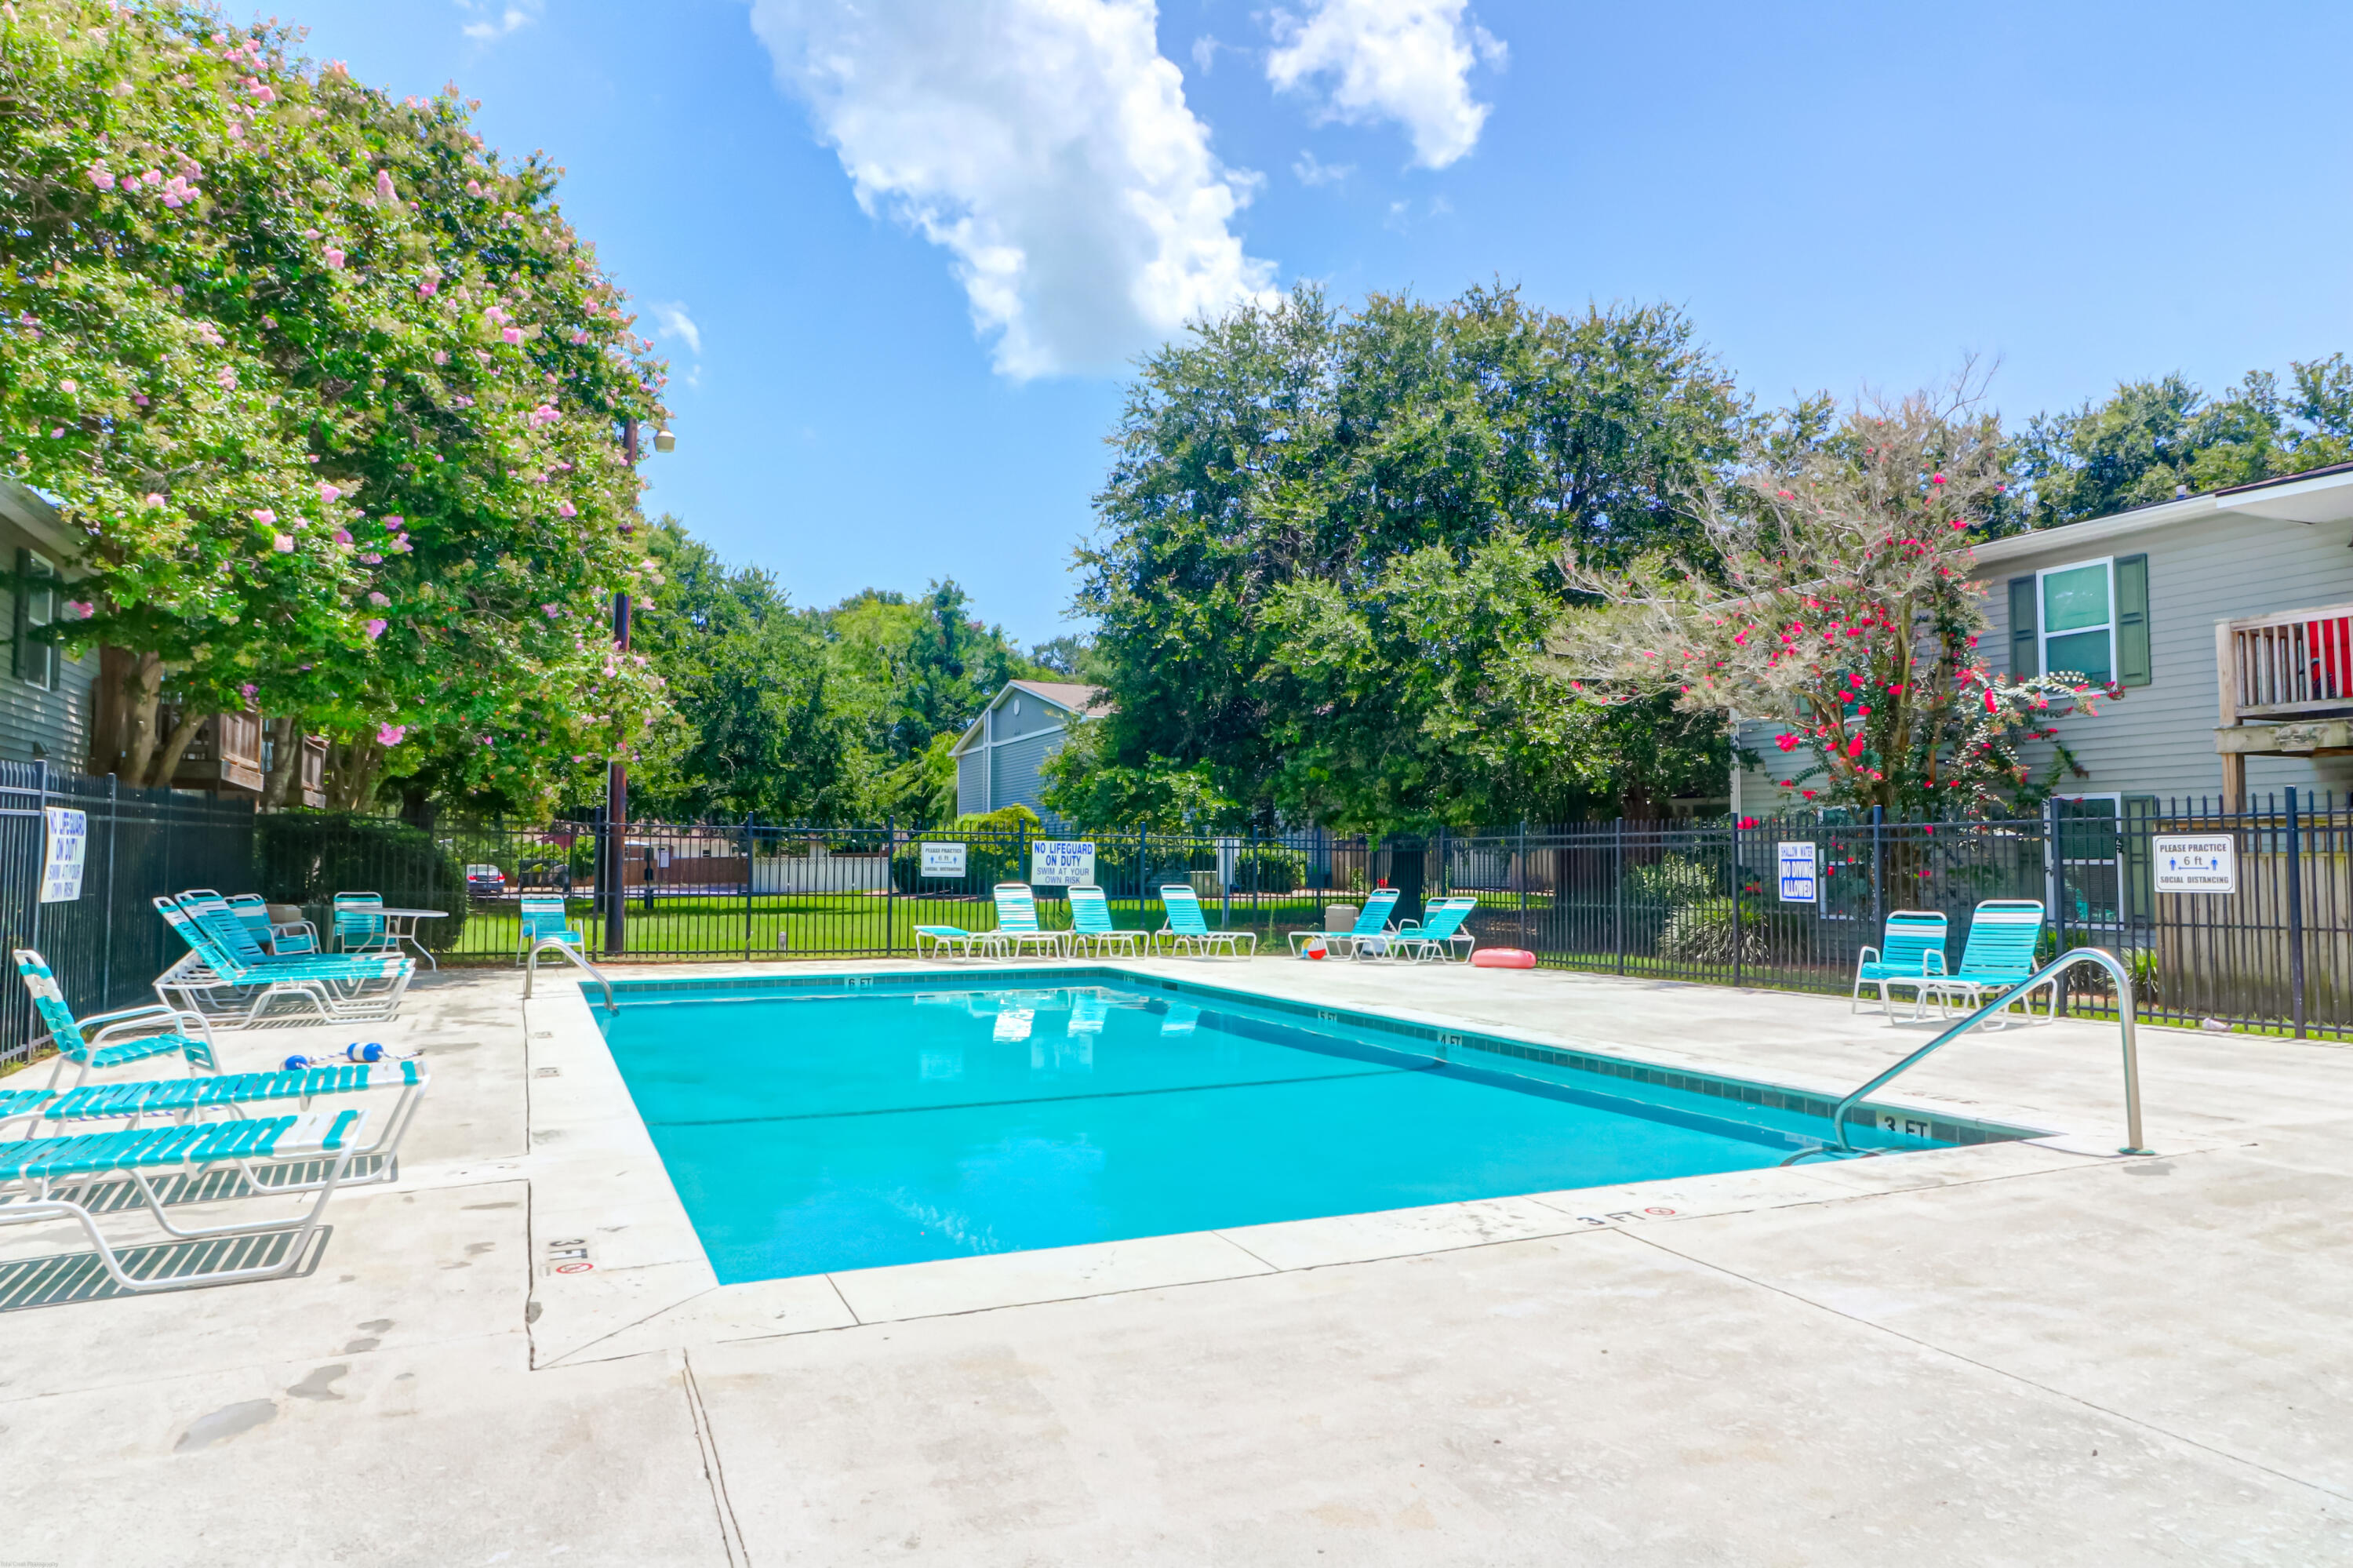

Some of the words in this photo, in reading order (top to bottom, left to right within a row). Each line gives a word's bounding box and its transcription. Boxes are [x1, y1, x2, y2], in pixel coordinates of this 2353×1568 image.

[49, 811, 57, 835] NO
[60, 812, 84, 836] LIFEGUARD
[56, 837, 64, 861] ON
[64, 838, 78, 861] DUTY
[1035, 842, 1046, 853] NO
[1049, 842, 1093, 855] LIFEGUARD
[1781, 846, 1798, 857] SHALLOW
[1800, 846, 1813, 857] WATER
[2159, 844, 2187, 853] PLEASE
[2188, 843, 2227, 852] PRACTICE
[1046, 855, 1056, 866] ON
[1060, 855, 1081, 867] DUTY
[2184, 856, 2191, 865] 6
[2195, 855, 2202, 865] ft
[1037, 867, 1055, 875] SWIM
[1058, 867, 1067, 875] AT
[1071, 868, 1089, 876] YOUR
[1781, 860, 1791, 878] NO
[1791, 860, 1813, 878] DIVING
[1045, 875, 1062, 884] OWN
[1064, 875, 1080, 884] RISK
[1784, 879, 1813, 898] ALLOWED
[1884, 1116, 1896, 1131] 3
[1905, 1119, 1928, 1137] FT
